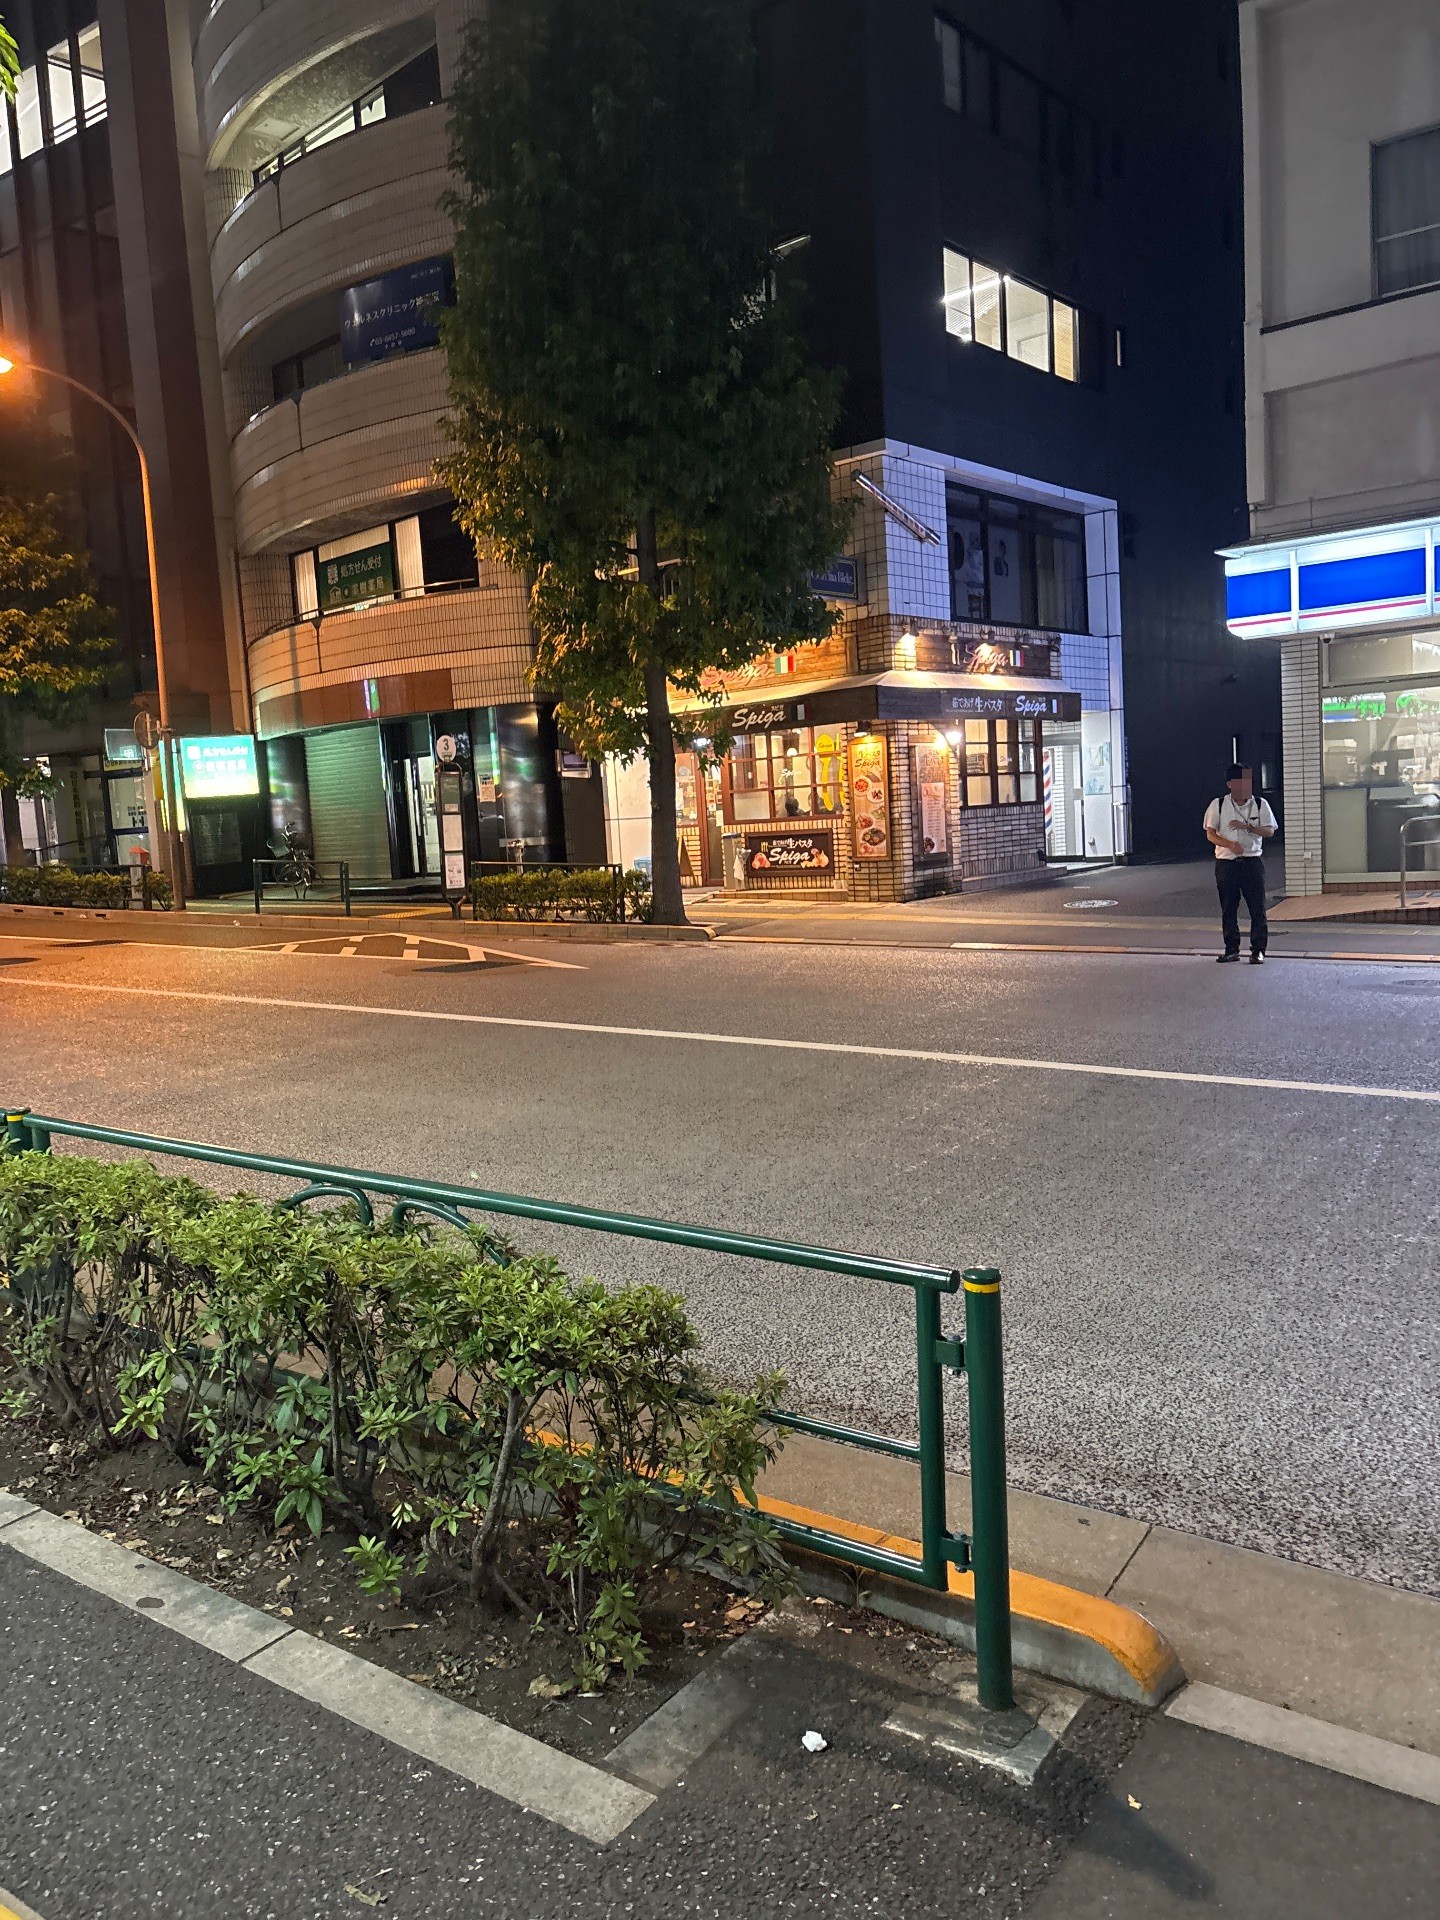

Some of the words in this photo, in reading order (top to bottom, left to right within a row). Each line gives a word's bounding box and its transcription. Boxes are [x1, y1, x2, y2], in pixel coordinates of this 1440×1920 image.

[340, 554, 382, 578] 処方せん受付
[1014, 694, 1048, 717] Spiga
[731, 707, 787, 731] Spiga
[442, 738, 450, 751] 3
[854, 758, 882, 770] Spiga
[768, 847, 810, 865] Spiga
